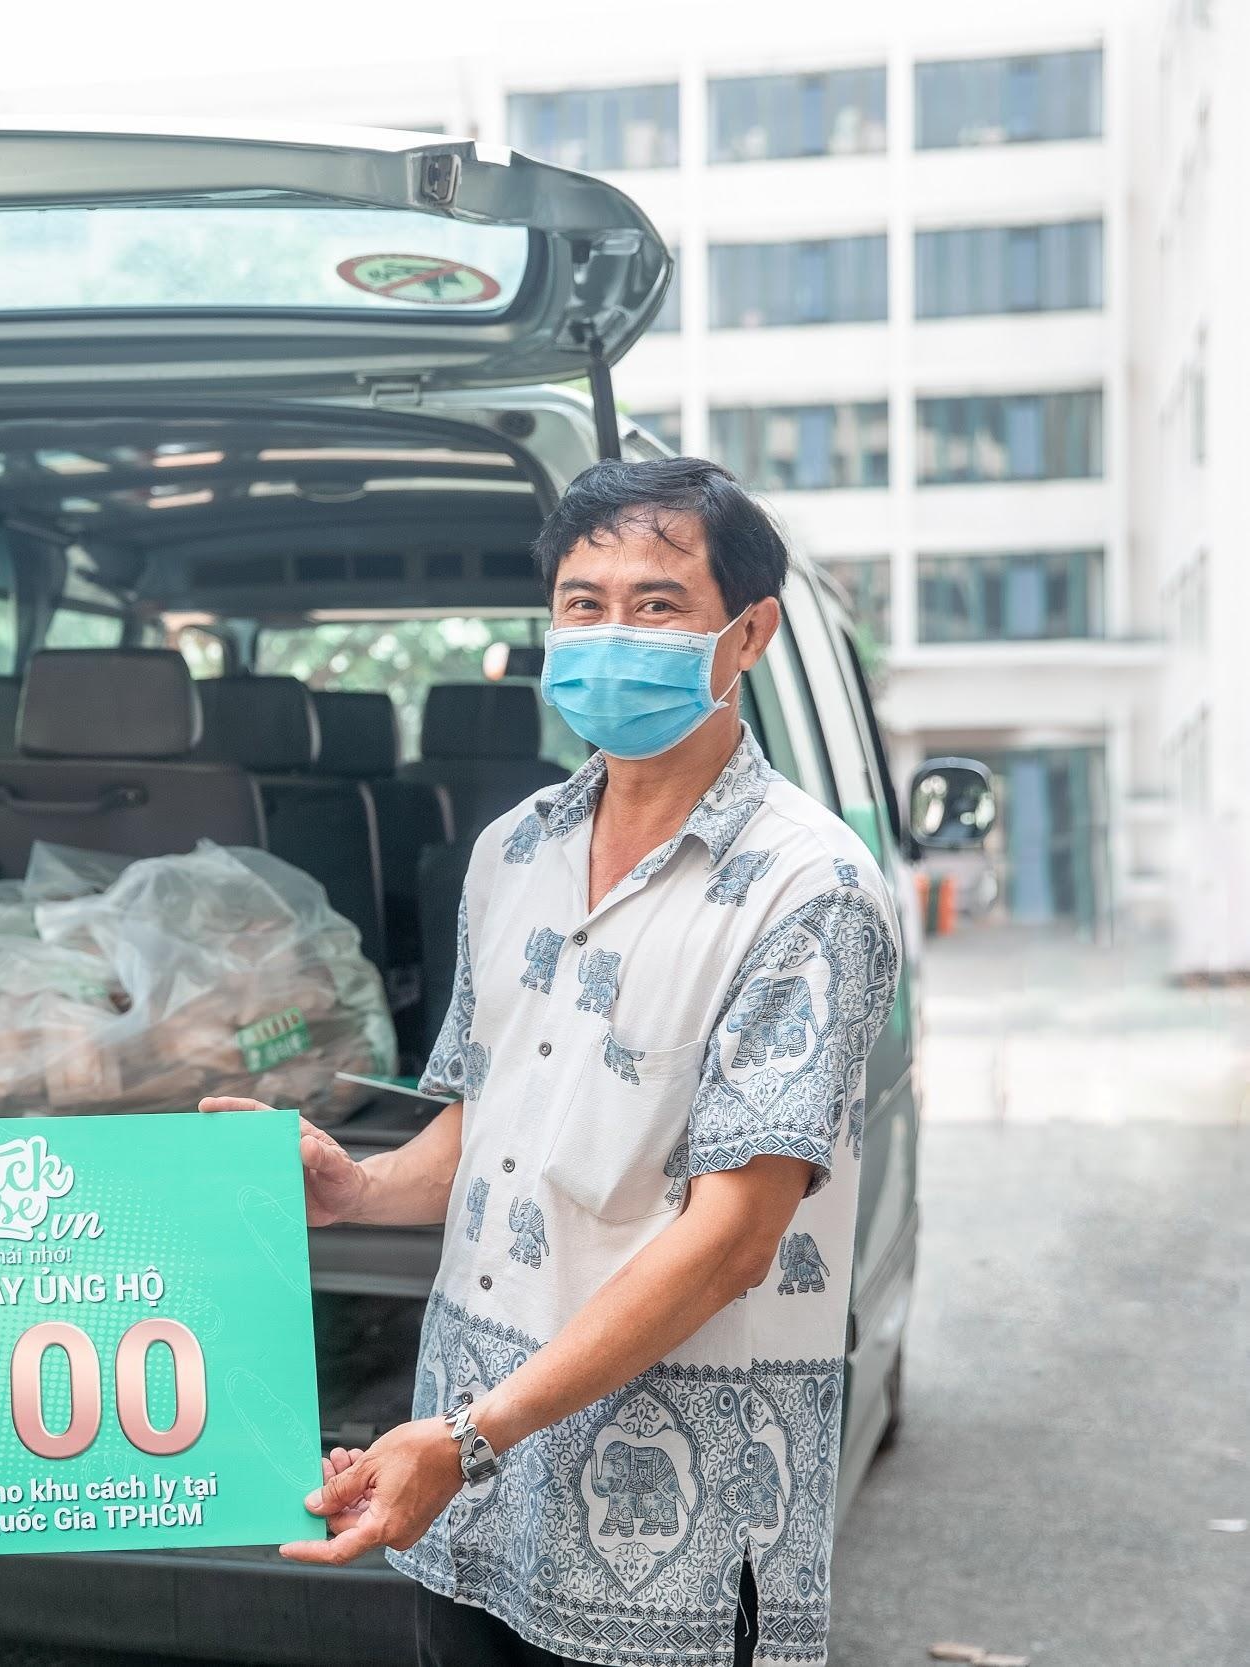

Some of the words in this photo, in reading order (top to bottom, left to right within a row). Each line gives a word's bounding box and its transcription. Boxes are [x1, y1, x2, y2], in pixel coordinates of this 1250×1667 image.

[29, 1245, 73, 1264] nhớ!
[33, 1267, 107, 1304] ỦNG
[115, 1264, 165, 1307] HỘ
[30, 1477, 79, 1502] khu
[85, 1474, 147, 1501] cách
[153, 1473, 177, 1504] ly
[182, 1471, 218, 1501] tại
[53, 1505, 98, 1531] Gia
[102, 1502, 204, 1529] TPHCM
